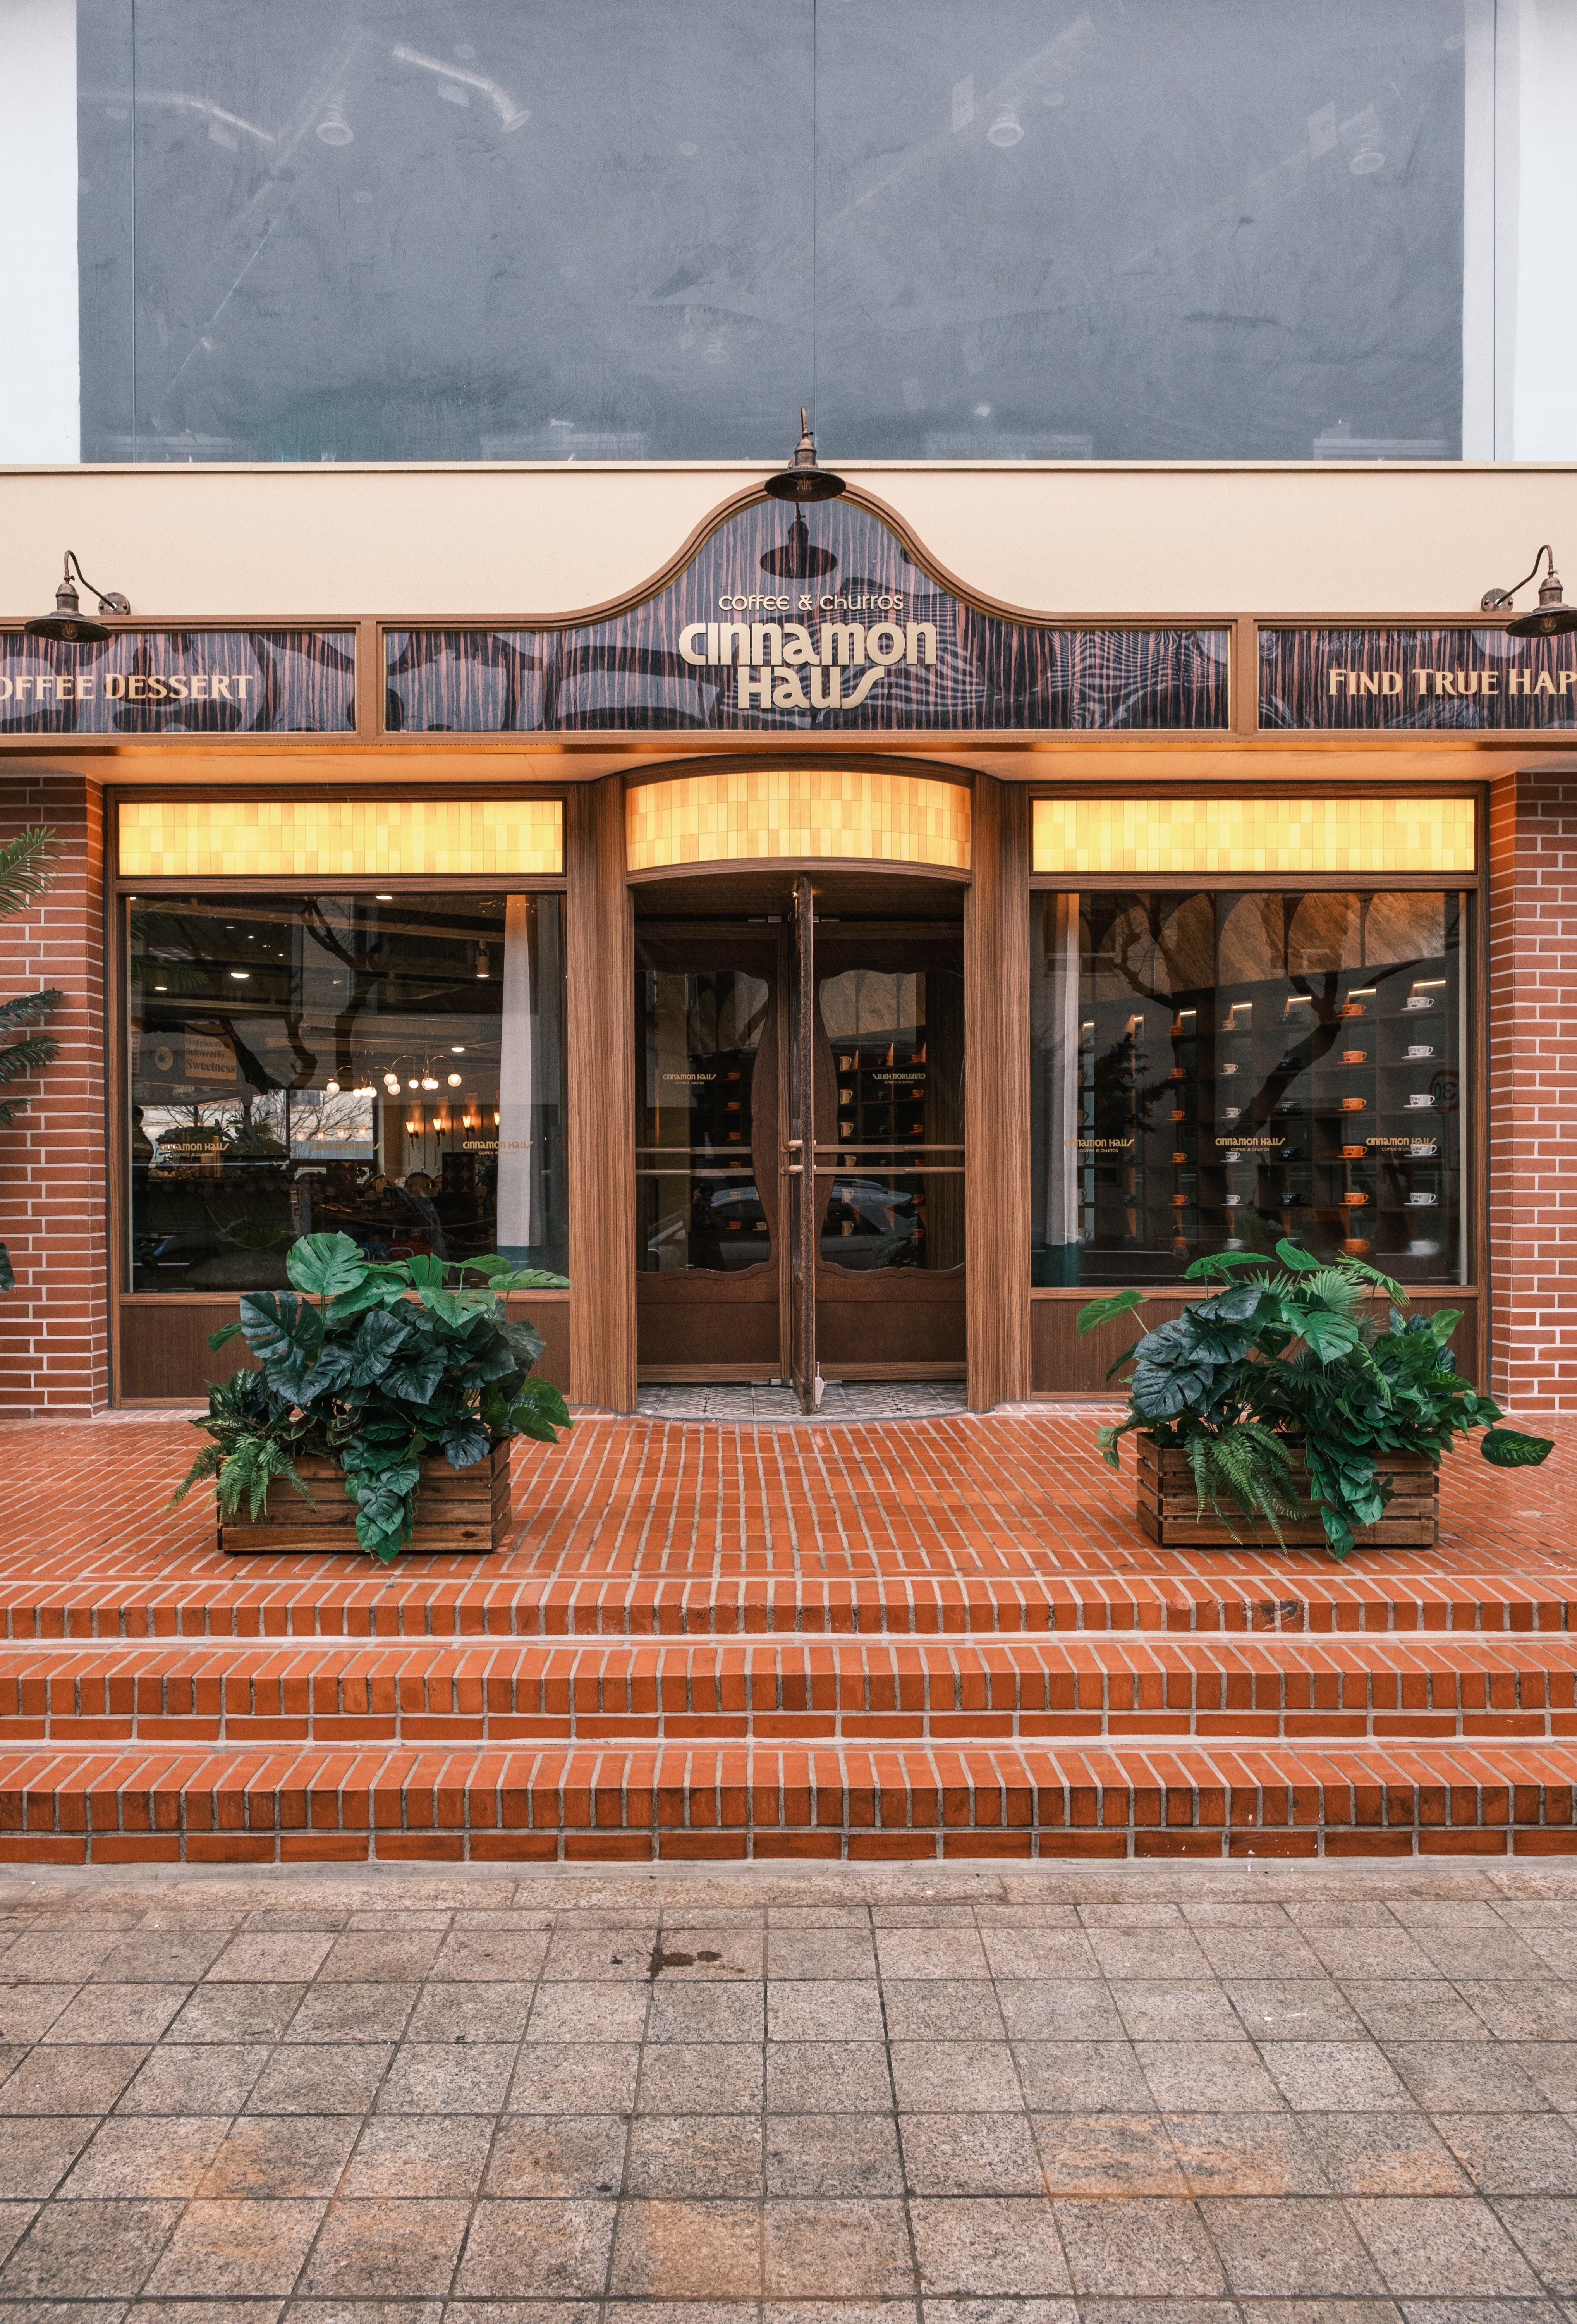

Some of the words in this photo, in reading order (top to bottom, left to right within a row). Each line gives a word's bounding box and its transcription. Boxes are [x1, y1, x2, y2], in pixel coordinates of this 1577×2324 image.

[798, 595, 813, 610] &
[679, 622, 936, 665] cinnamon
[104, 673, 253, 699] DESSERT
[738, 666, 885, 709] Haus
[1328, 669, 1403, 695] FIND
[1412, 669, 1500, 695] TRUE
[1508, 669, 1577, 694] HAP
[186, 1037, 223, 1048] Happiness
[186, 1048, 216, 1058] Delivered
[186, 1059, 236, 1073] Sweetness
[508, 1141, 533, 1149] Haus
[1260, 1138, 1285, 1146] Haus
